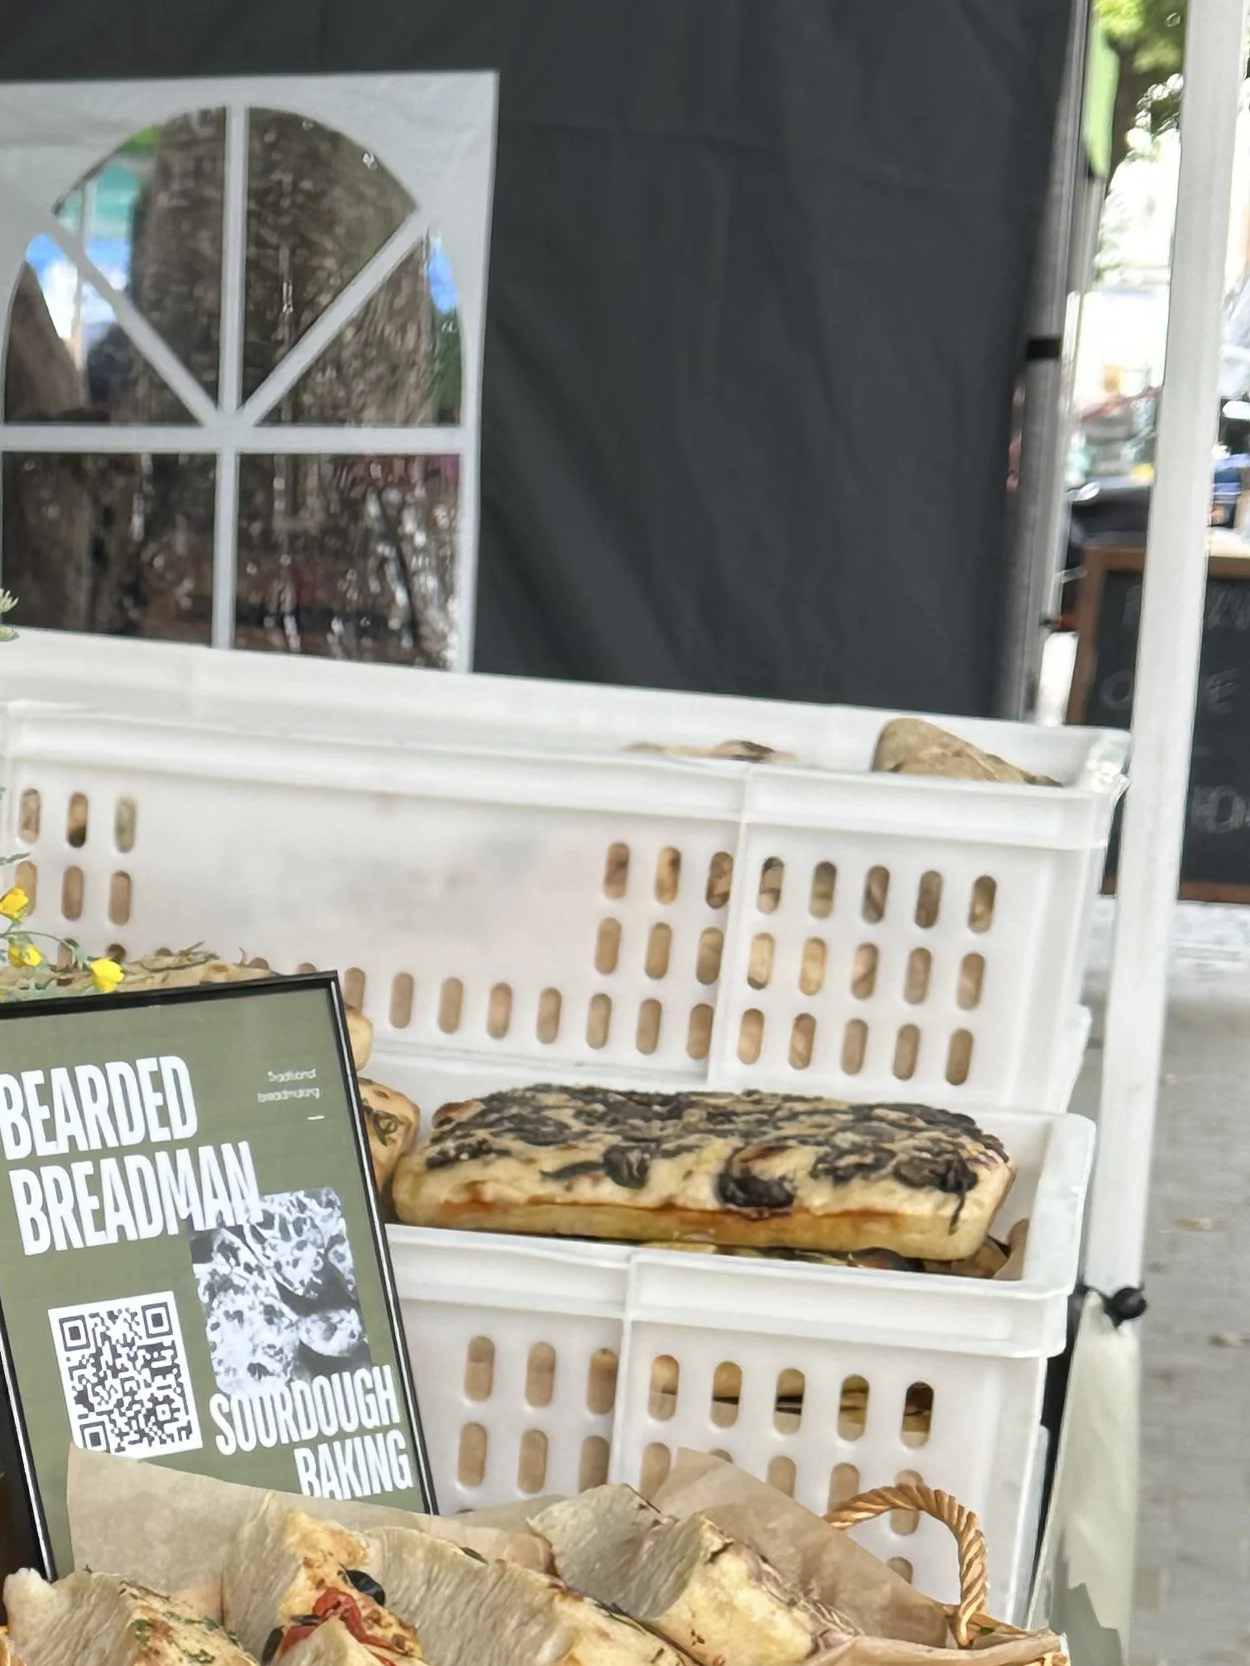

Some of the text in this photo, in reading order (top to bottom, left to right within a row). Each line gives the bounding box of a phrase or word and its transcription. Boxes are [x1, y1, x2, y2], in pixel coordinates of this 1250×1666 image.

[8, 1141, 264, 1256] BREADMAN
[209, 1365, 400, 1455] SOURDOUGH
[294, 1434, 413, 1500] BAKING
